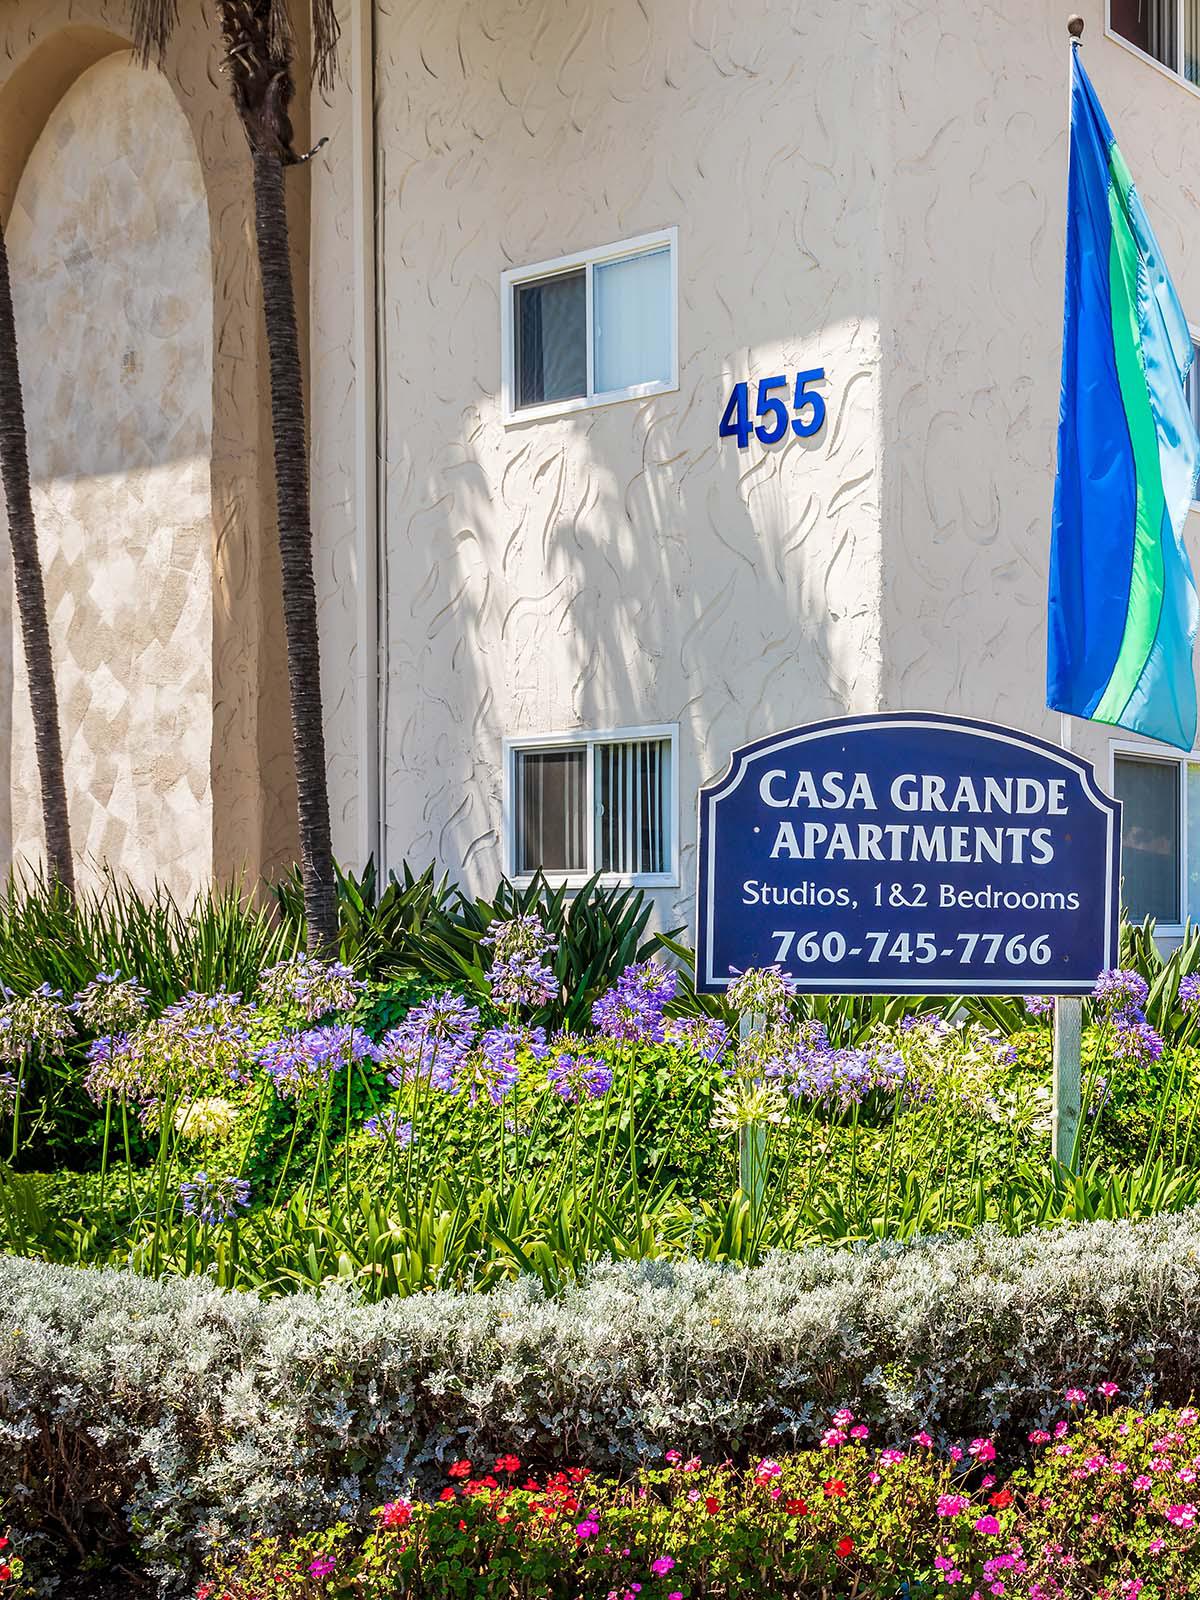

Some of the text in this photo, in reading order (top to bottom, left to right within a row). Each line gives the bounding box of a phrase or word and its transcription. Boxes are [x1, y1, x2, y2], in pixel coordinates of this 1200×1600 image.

[719, 367, 826, 448] 455
[759, 770, 1068, 815] CASA GRANDE
[769, 822, 1054, 864] APARTMENTS
[743, 880, 1079, 910] Studios, 1&2 Bedrooms
[771, 930, 1052, 966] 760-745-7766
